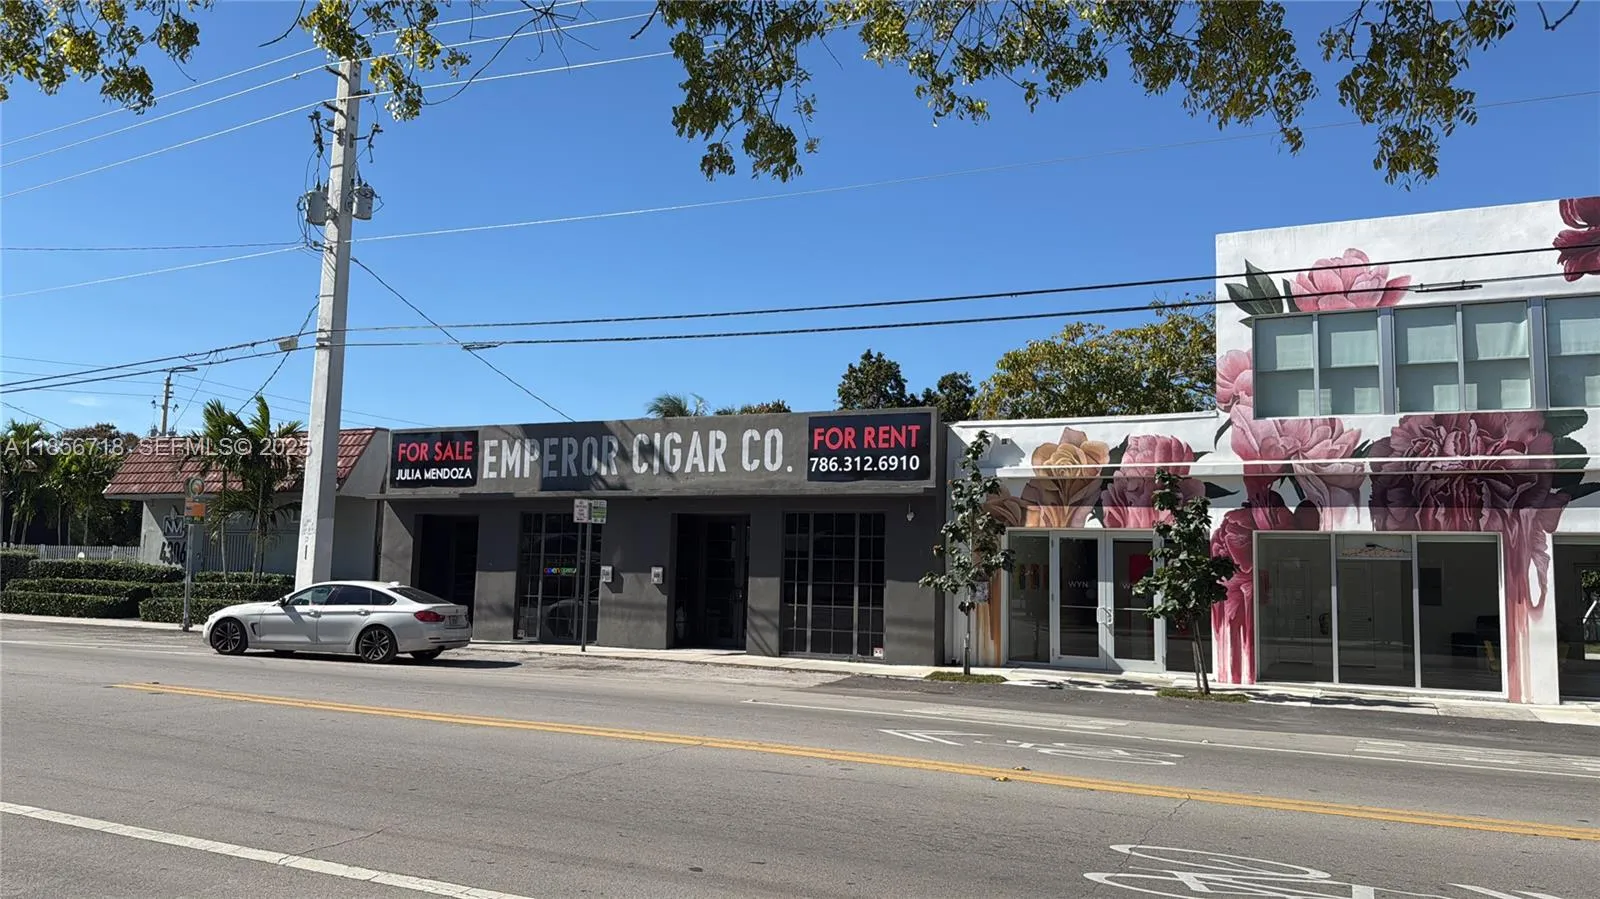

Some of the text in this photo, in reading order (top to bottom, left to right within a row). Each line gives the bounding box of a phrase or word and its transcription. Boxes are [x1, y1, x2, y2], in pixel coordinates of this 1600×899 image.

[813, 424, 921, 450] FOR RENT
[397, 440, 473, 462] FOR SALE
[482, 428, 793, 479] EMPEROR CIGAR CO.
[396, 467, 472, 480] JULIA MENDOZA
[809, 455, 920, 472] 786.312.6910
